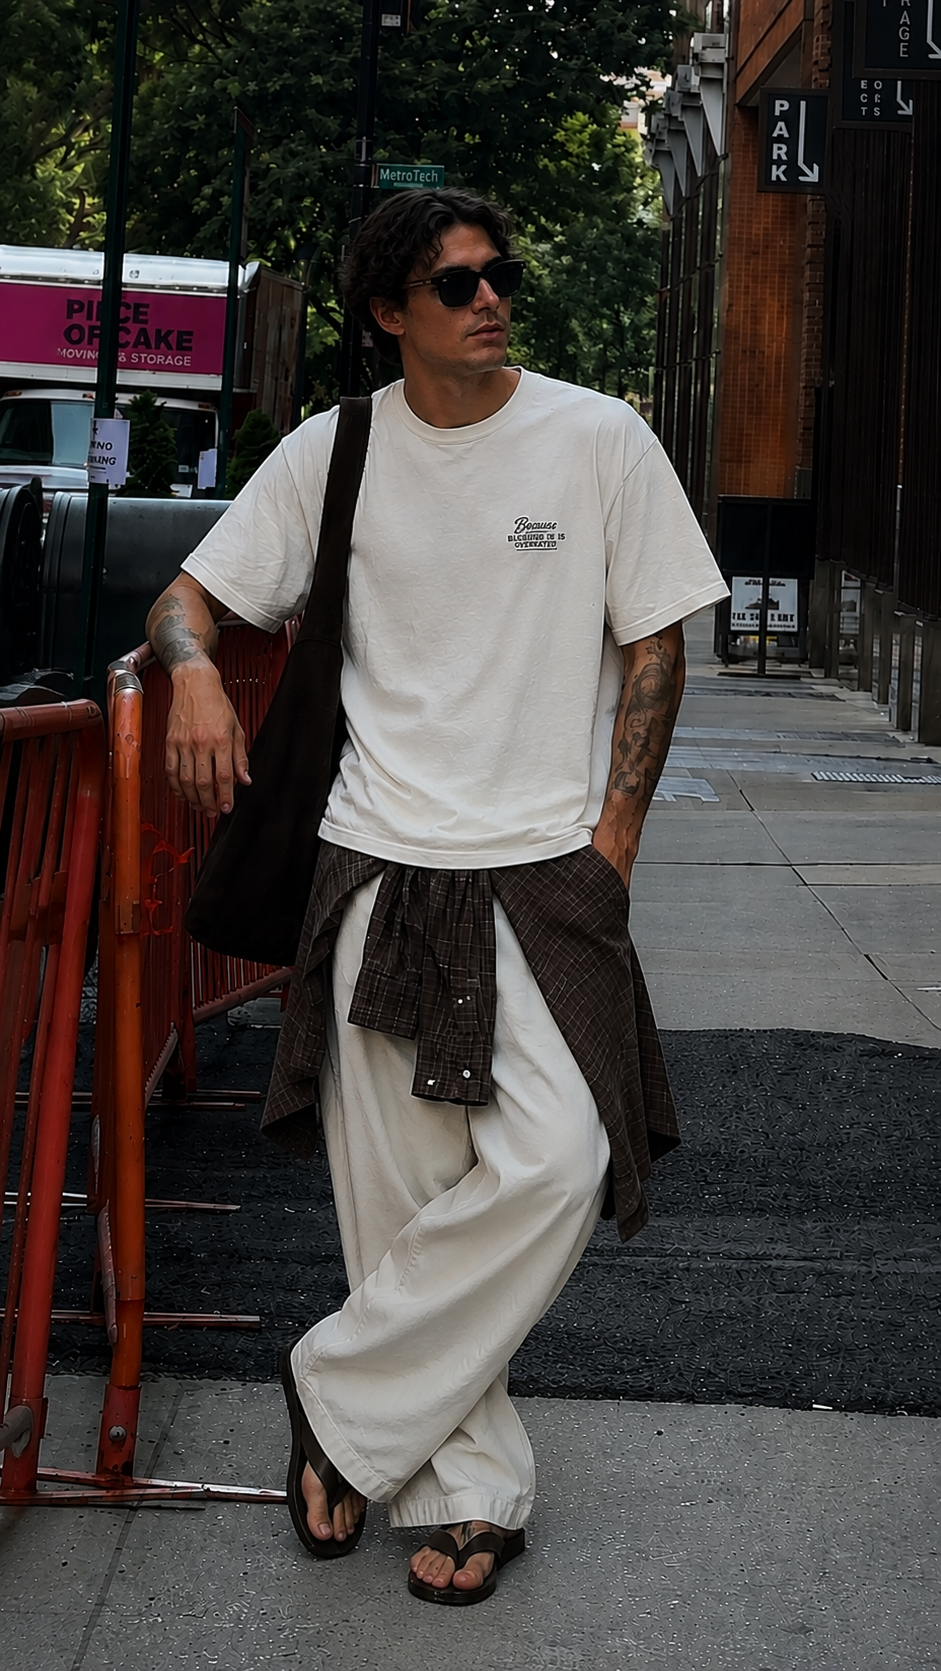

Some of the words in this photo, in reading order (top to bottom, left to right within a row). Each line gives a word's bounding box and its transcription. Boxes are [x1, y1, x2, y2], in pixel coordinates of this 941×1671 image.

[771, 99, 790, 182] PARK
[380, 168, 438, 183] MetroTech
[118, 326, 194, 352] CAKE
[131, 353, 192, 366] STORAGE
